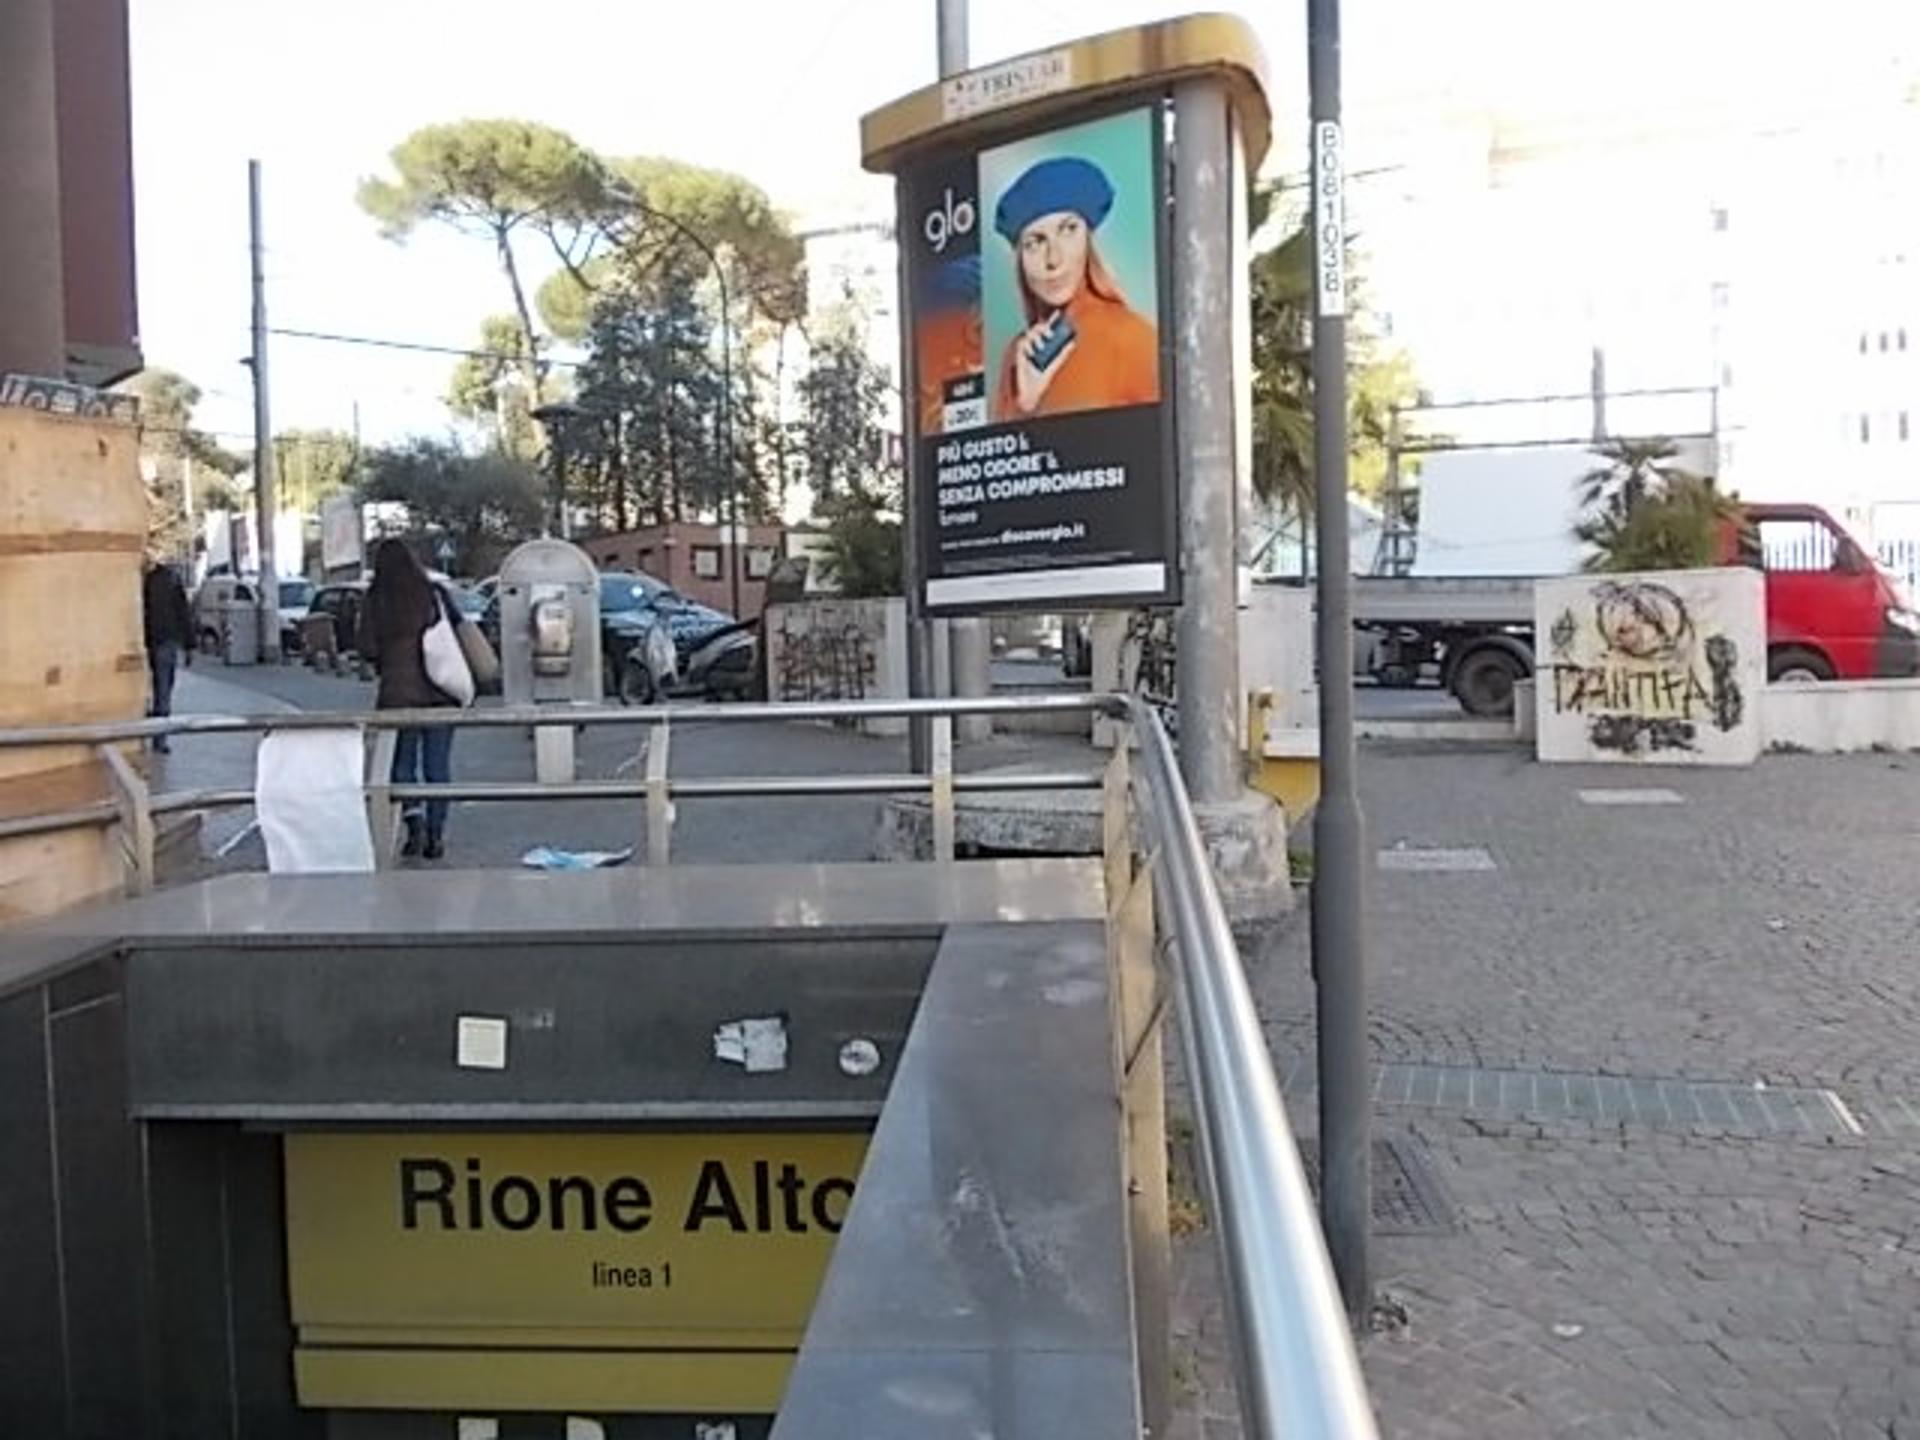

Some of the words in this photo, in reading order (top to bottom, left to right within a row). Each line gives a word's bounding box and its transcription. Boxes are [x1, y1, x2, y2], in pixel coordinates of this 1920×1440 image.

[925, 187, 976, 253] glo
[962, 433, 1018, 460] GUSTO
[938, 461, 982, 486] MENO
[938, 484, 986, 507] SENZA
[986, 467, 1126, 500] COMPROMESSI
[400, 1157, 654, 1233] Rione
[683, 1159, 858, 1234] Alto
[592, 1261, 653, 1288] linea
[662, 1262, 673, 1288] 1
